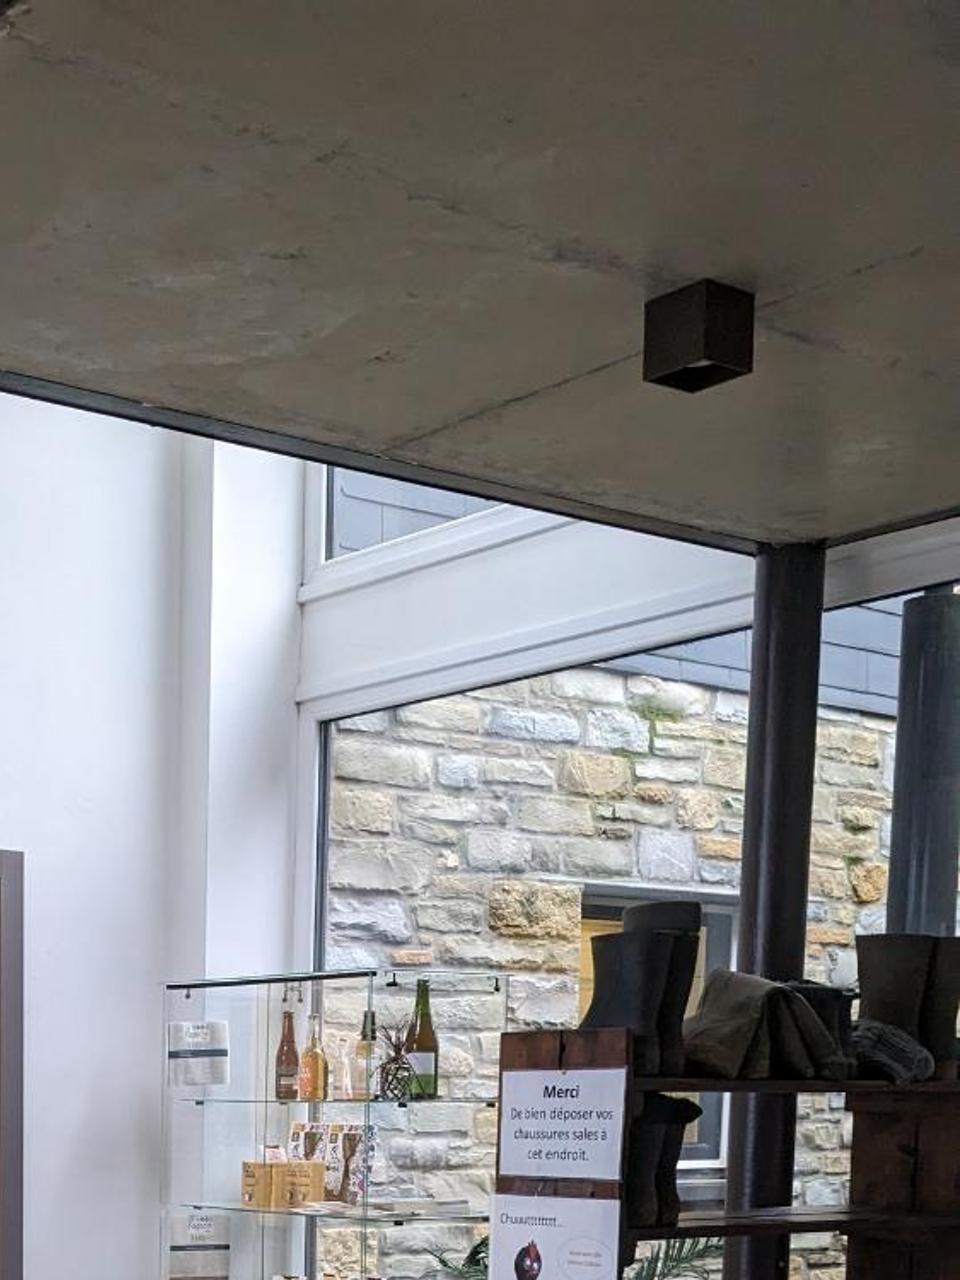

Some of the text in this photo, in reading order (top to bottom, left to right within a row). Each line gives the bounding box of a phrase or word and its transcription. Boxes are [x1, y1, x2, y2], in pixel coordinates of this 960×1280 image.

[543, 1085, 580, 1099] Merci
[510, 1107, 614, 1122] De bien déposer vos
[513, 1127, 570, 1140] chaussures
[572, 1127, 599, 1141] sales
[527, 1148, 589, 1161] cet endroit.
